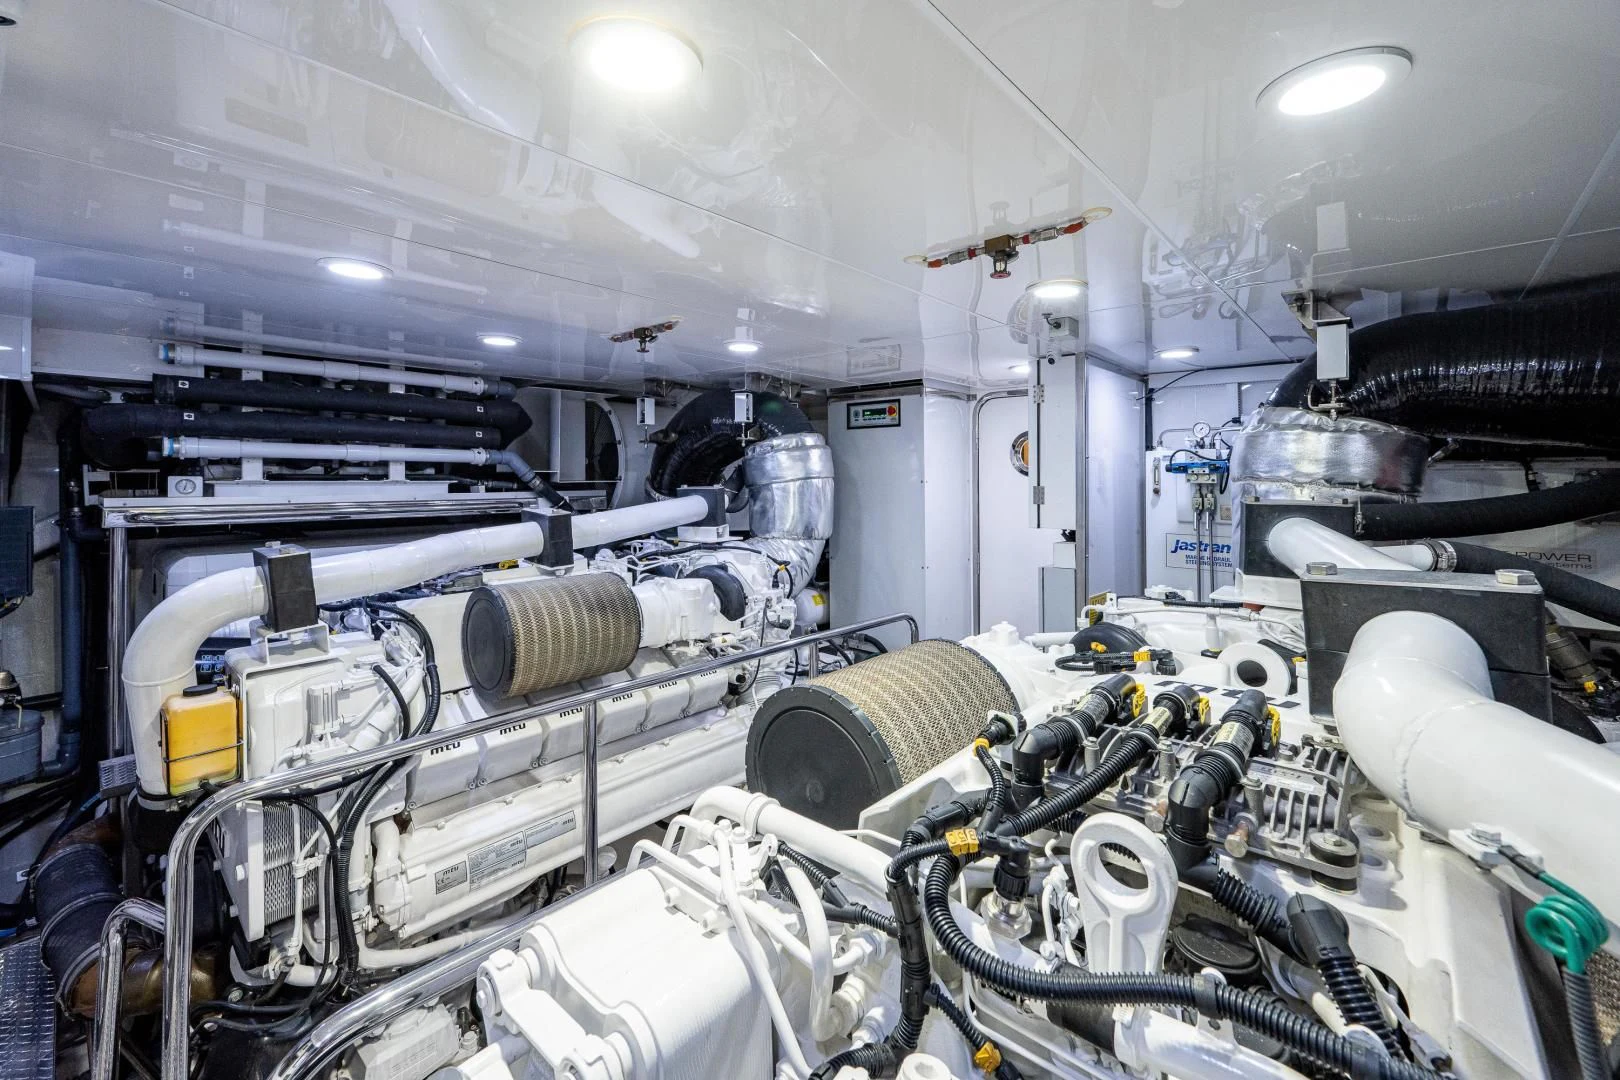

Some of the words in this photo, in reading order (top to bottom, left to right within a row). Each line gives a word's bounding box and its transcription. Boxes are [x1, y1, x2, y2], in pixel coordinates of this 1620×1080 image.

[1170, 539, 1232, 553] Jastran
[1515, 551, 1592, 562] POWER
[658, 681, 678, 690] mtu
[612, 693, 633, 703] mtu
[559, 706, 583, 718] mtu
[499, 722, 526, 736] mtu
[430, 741, 461, 756] mtu
[562, 818, 574, 826] mtu
[509, 839, 524, 848] mtu
[511, 859, 525, 867] mtu
[442, 865, 459, 877] mtu
